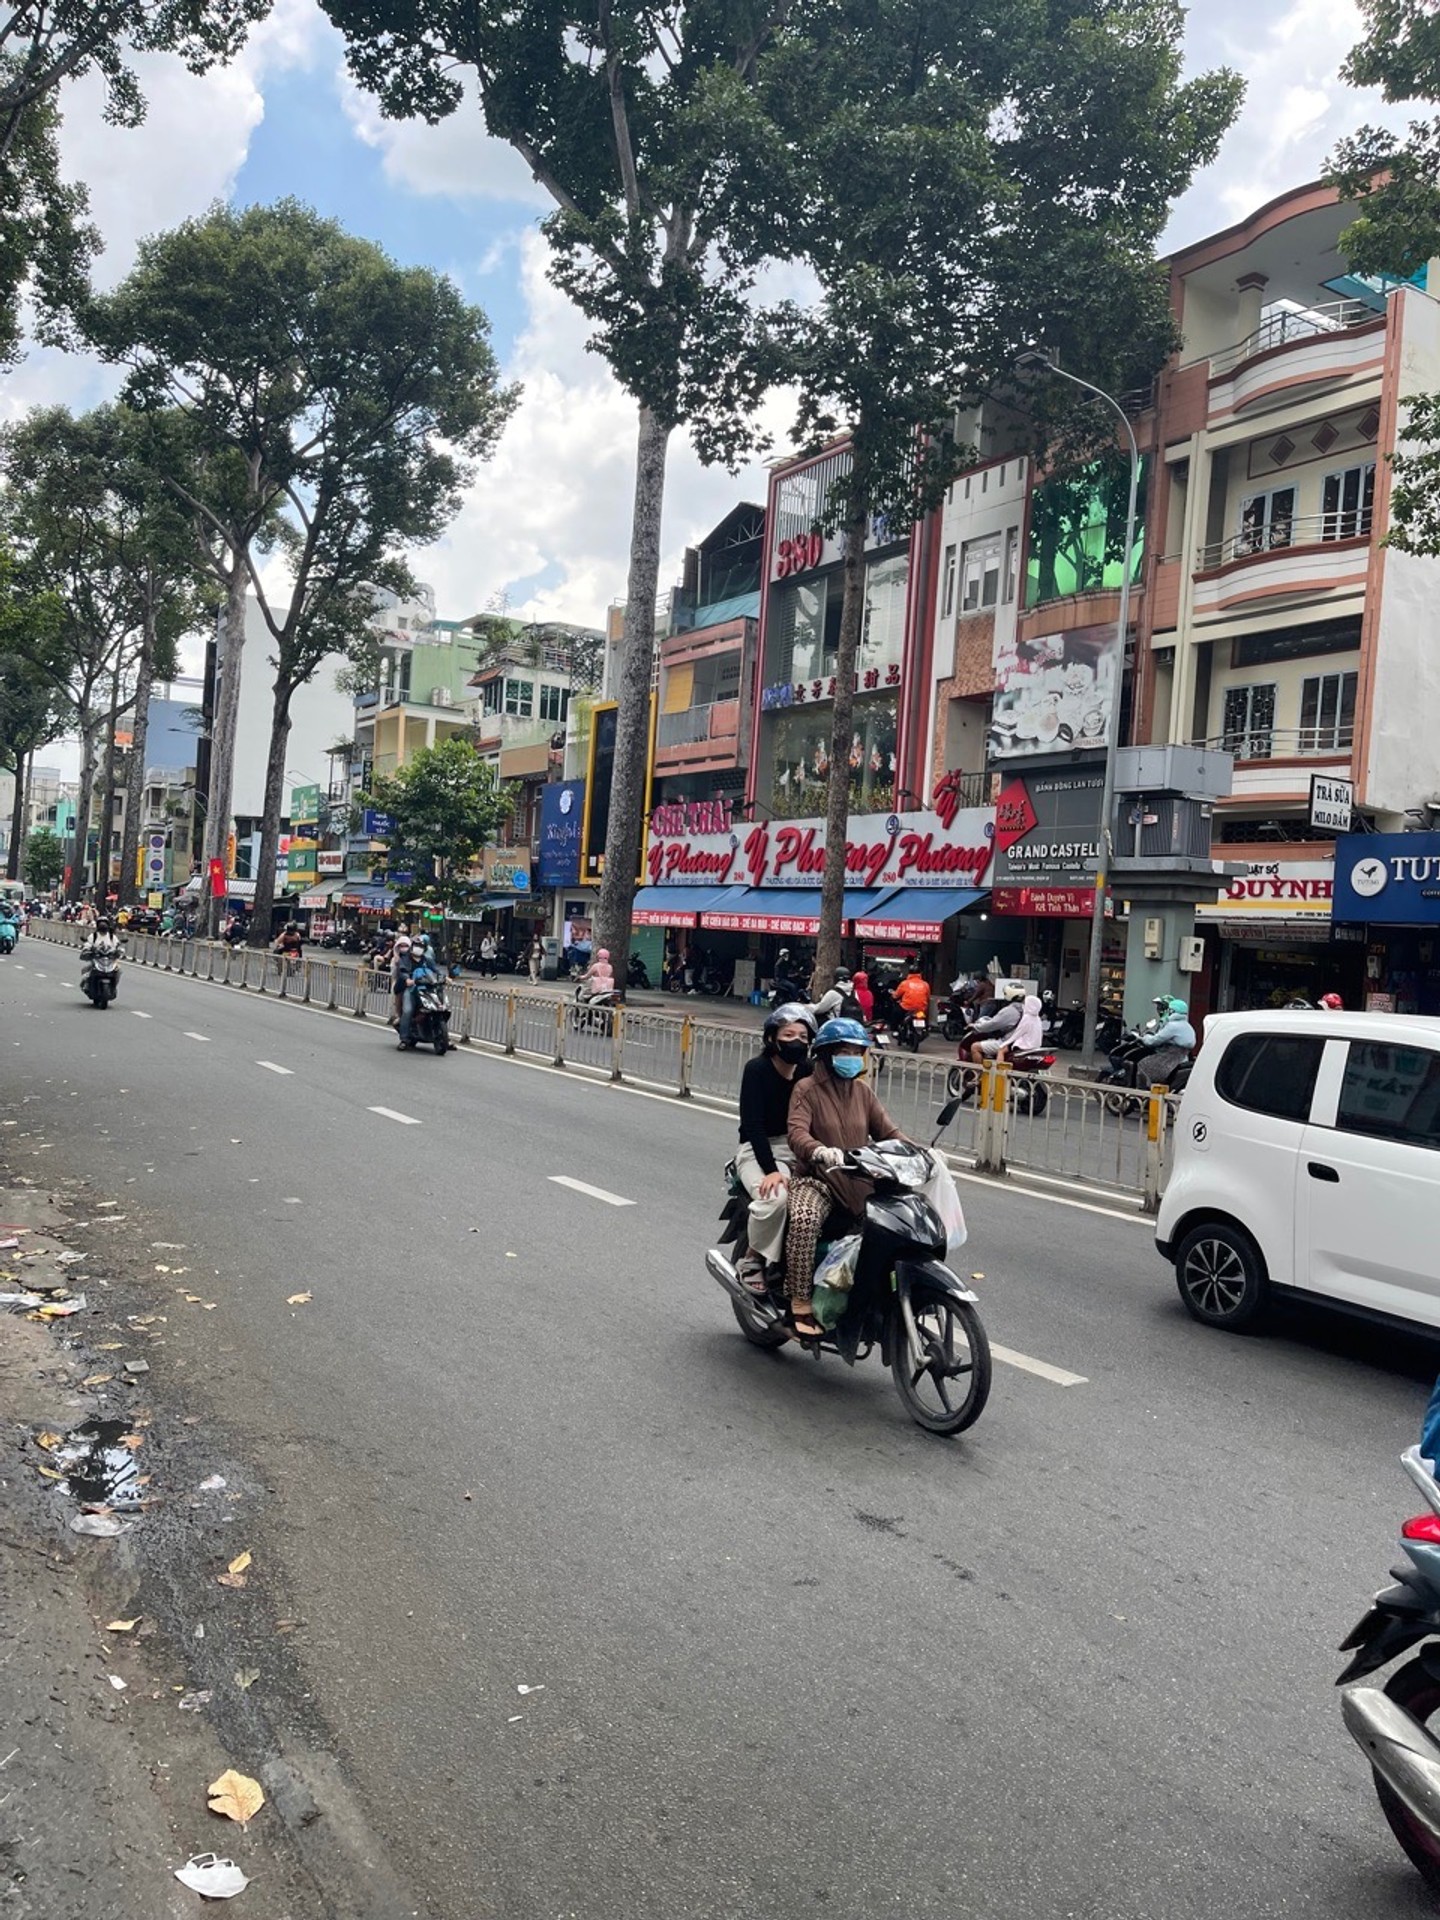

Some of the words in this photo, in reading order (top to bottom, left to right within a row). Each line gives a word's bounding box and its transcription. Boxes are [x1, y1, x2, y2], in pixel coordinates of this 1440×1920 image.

[776, 532, 823, 578] 380
[1073, 780, 1087, 789] LAN
[687, 791, 733, 835] THÁI
[1314, 810, 1331, 824] MILO
[744, 820, 769, 887] Ý
[773, 827, 896, 887] Phng
[1007, 844, 1048, 859] GRAND
[1247, 864, 1264, 876] UẬT
[1266, 862, 1279, 875] SỐ
[1225, 874, 1333, 901] QUỲNH
